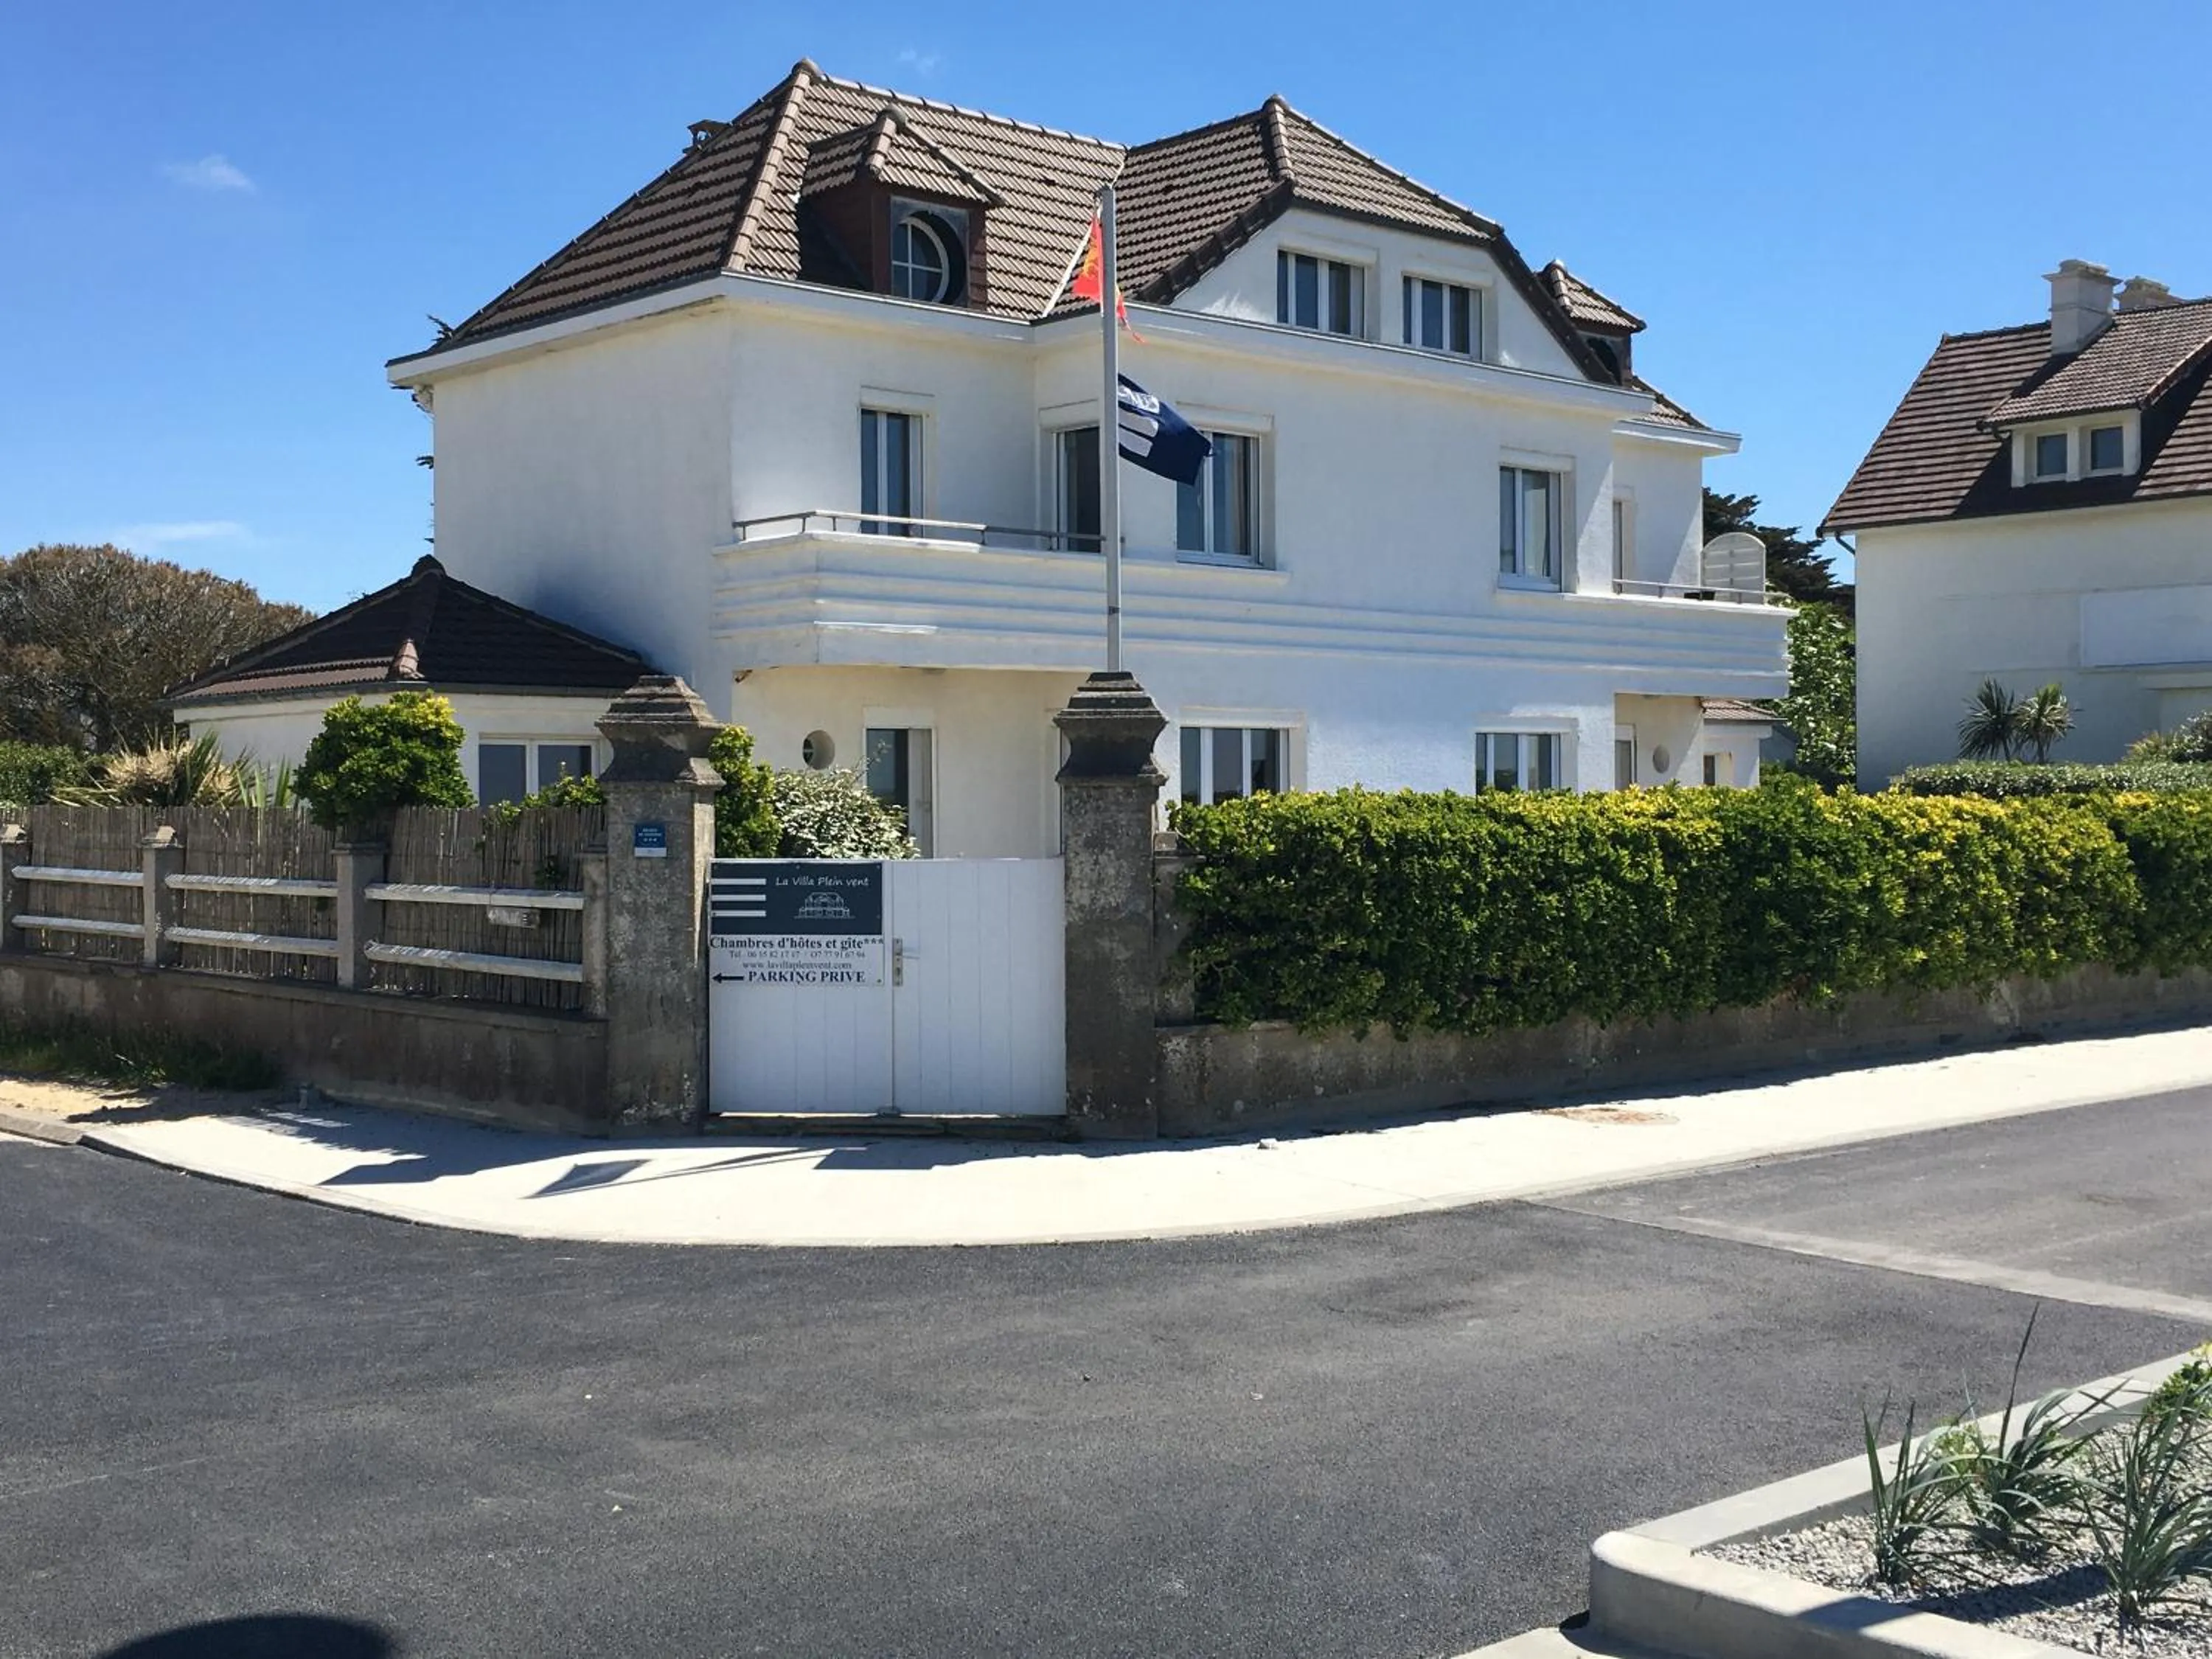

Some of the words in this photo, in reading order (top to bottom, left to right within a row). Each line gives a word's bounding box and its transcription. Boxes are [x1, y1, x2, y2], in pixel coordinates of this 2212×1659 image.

[776, 877, 788, 886] La
[793, 875, 814, 886] Villa
[818, 875, 843, 886] Plein
[846, 877, 869, 887] vent
[710, 936, 774, 949] Chambres
[778, 936, 822, 949] d'hôtes
[825, 939, 837, 949] et
[748, 971, 817, 983] PARKING
